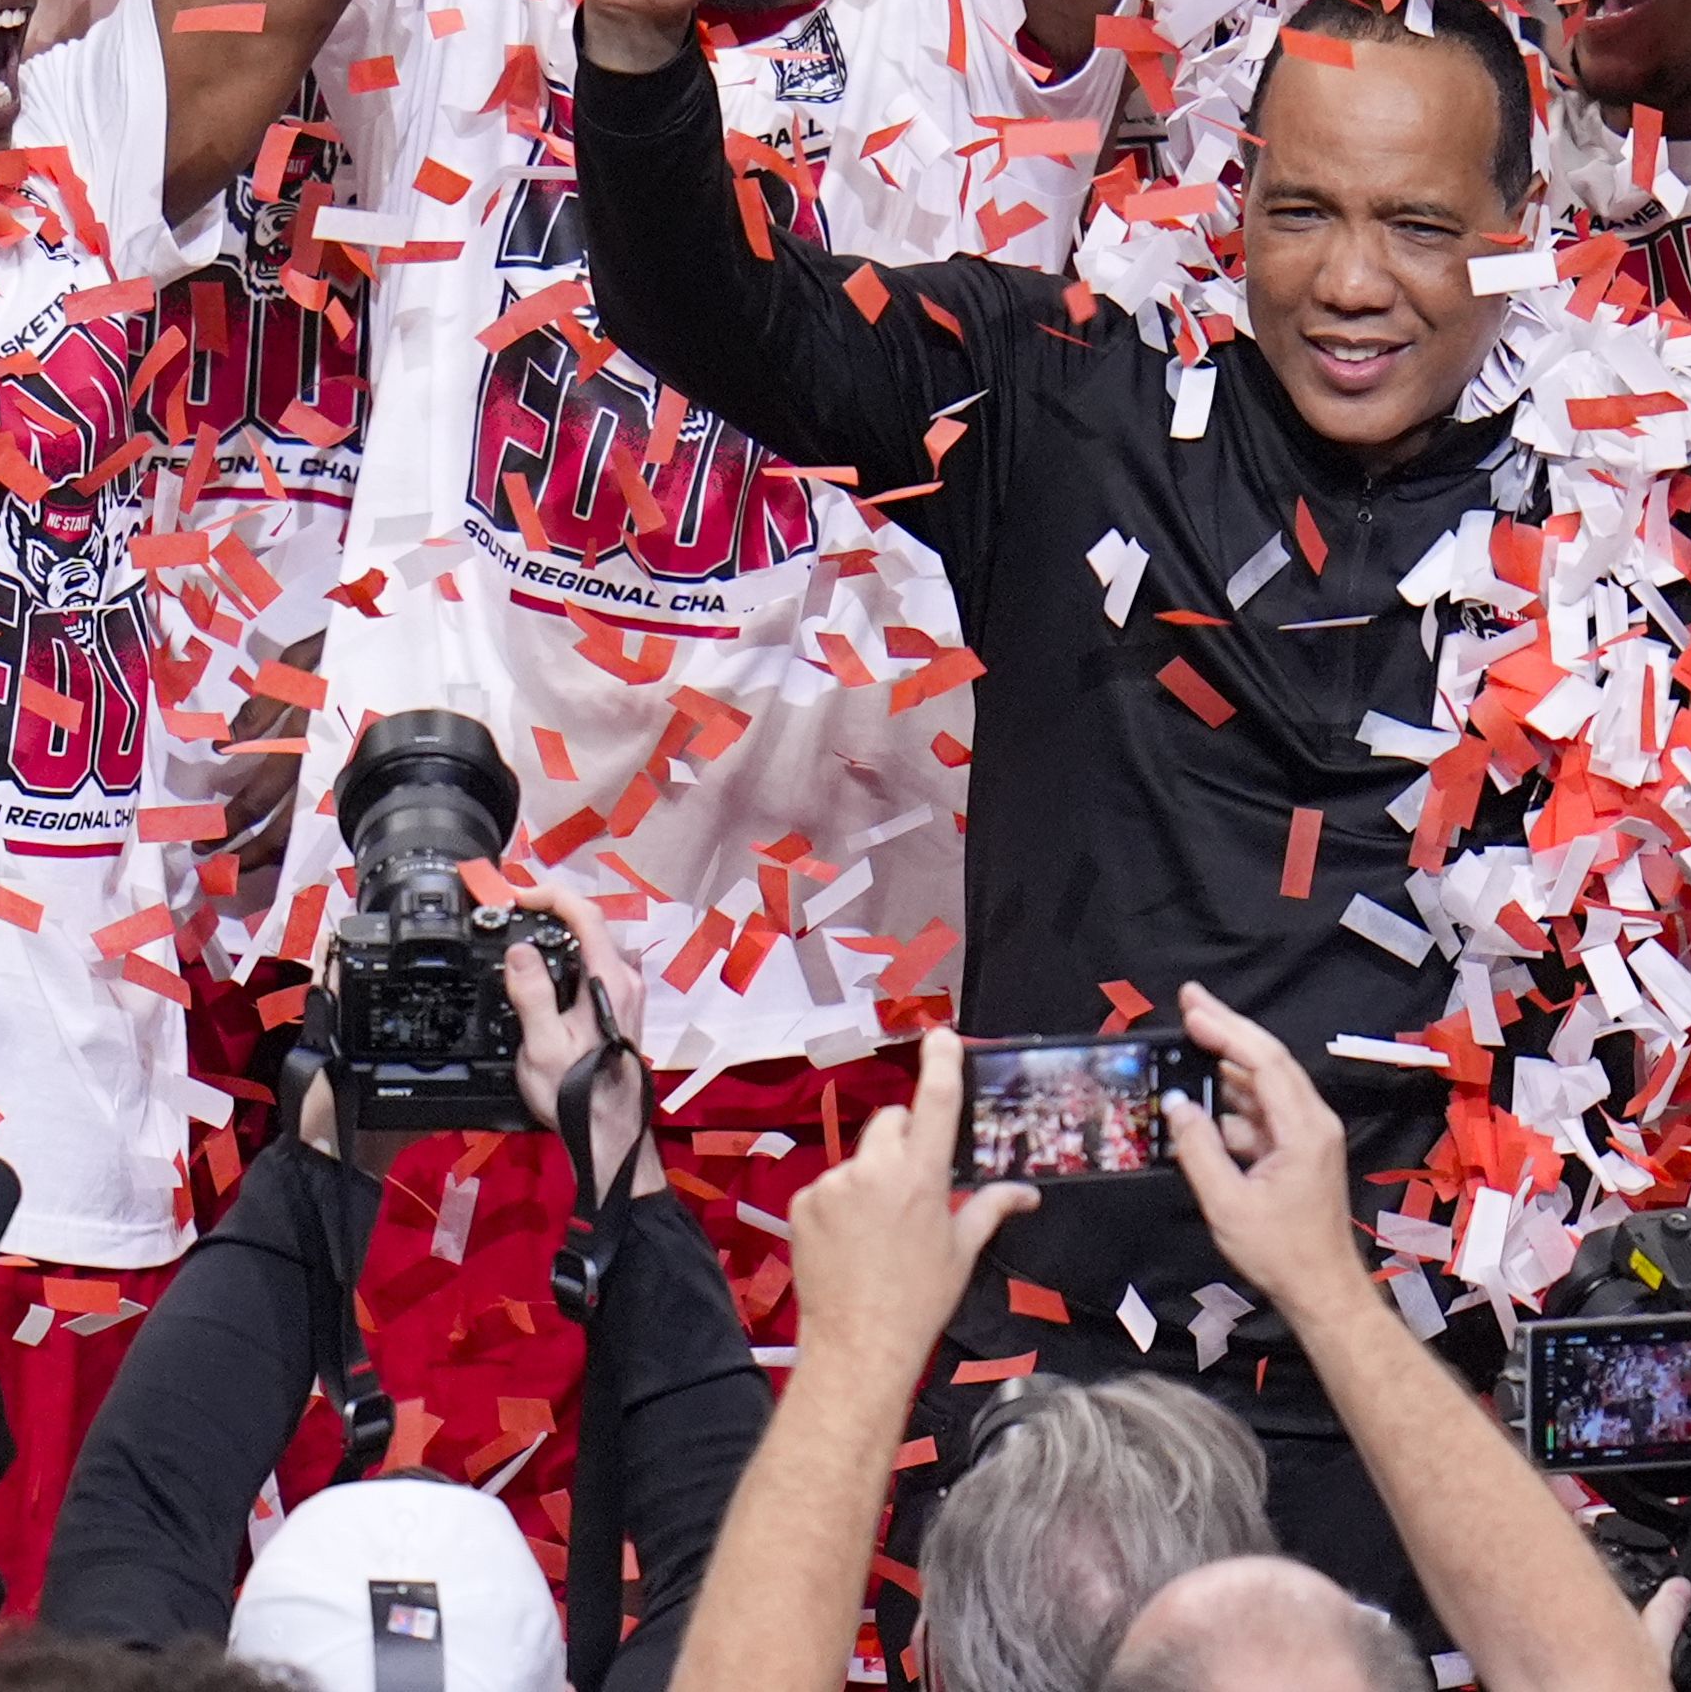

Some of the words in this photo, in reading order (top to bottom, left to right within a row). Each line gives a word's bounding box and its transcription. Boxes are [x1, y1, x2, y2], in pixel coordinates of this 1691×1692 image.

[46, 512, 62, 528] NC
[62, 514, 91, 532] STATE
[463, 517, 520, 575] SOUTH
[521, 560, 665, 610] REGIONAL
[4, 803, 112, 833] REGIONAL
[377, 1087, 414, 1099] SONY
